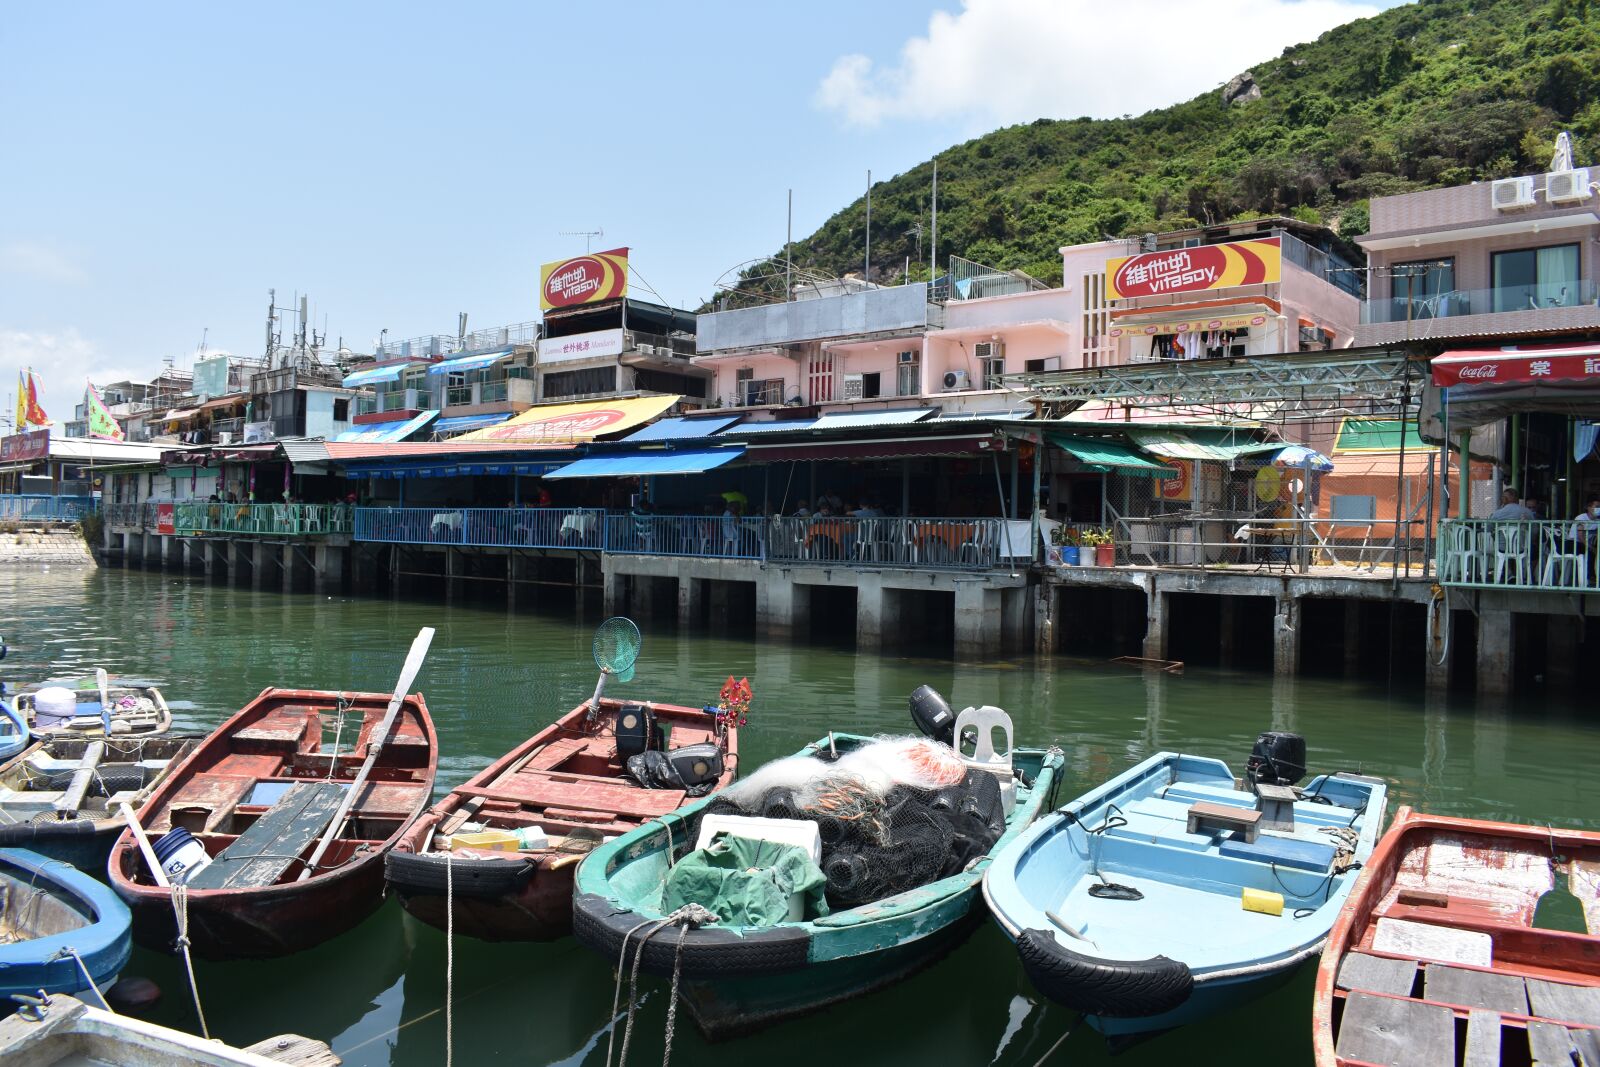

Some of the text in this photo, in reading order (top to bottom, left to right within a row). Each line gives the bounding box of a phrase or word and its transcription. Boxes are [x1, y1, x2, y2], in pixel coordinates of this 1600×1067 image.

[550, 266, 586, 294] 維他奶
[1125, 251, 1191, 287] 維他奶
